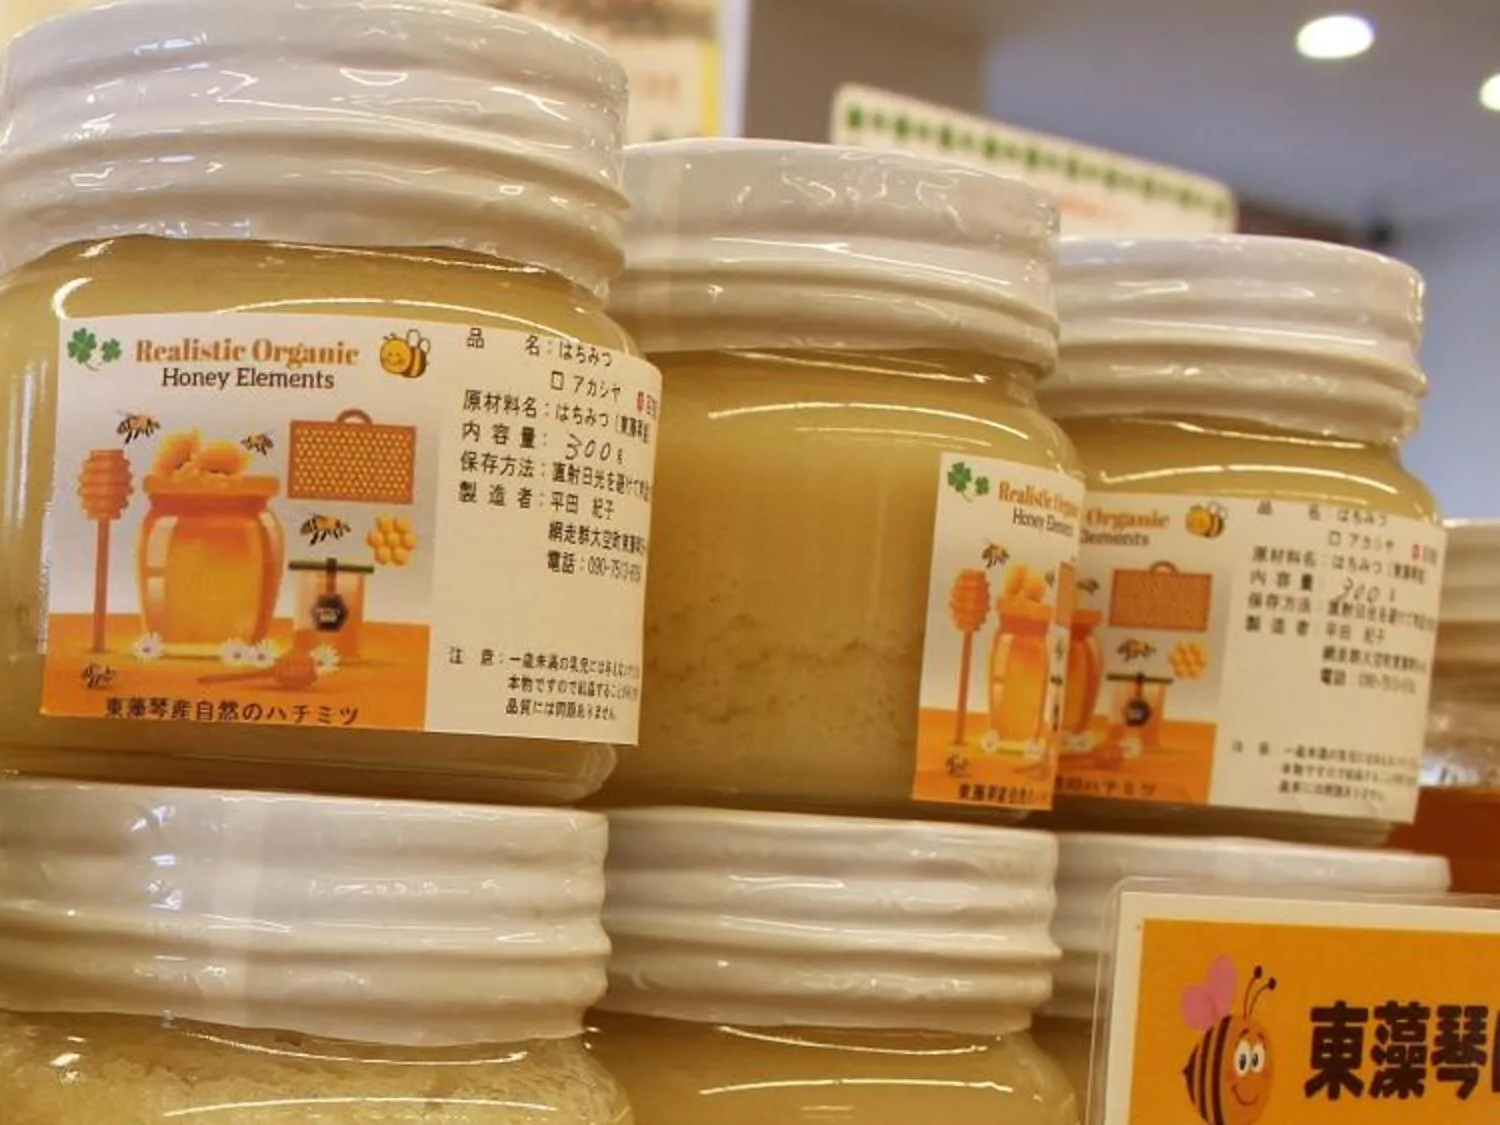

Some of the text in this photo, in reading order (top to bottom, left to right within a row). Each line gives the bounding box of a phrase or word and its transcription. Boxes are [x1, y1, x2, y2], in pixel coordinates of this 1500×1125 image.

[135, 337, 360, 370] Realistic Organic
[161, 366, 335, 390] Honey Elements
[998, 480, 1051, 508] Realistic
[1086, 508, 1170, 531] Organic
[1304, 1000, 1500, 1100] 東藻琴
